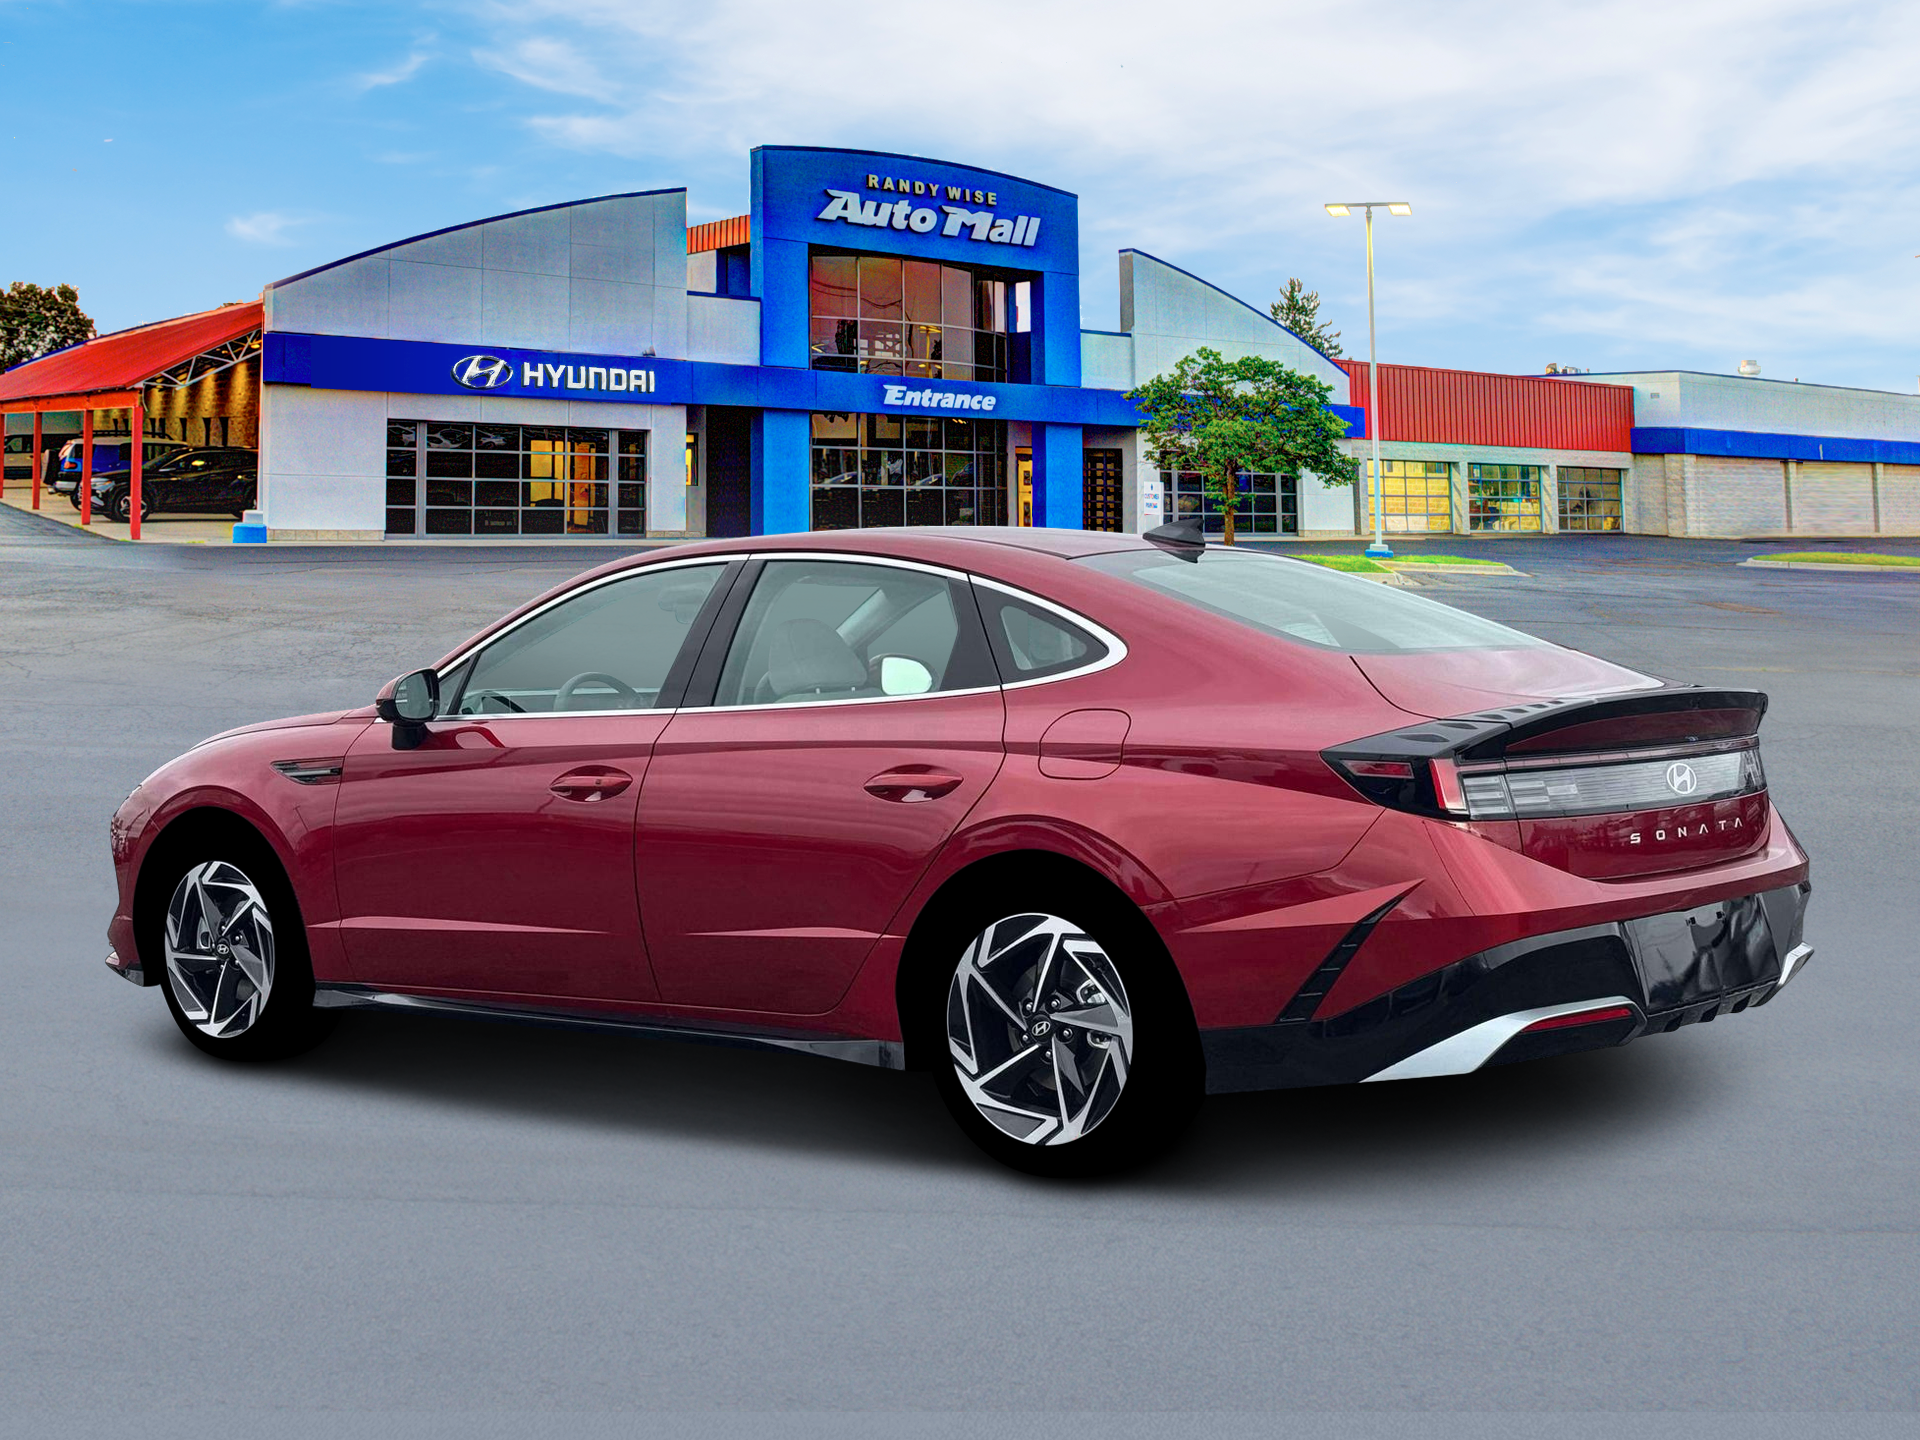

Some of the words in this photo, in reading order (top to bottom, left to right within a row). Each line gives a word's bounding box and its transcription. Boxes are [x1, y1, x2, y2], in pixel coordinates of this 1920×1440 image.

[867, 174, 939, 197] RANDY
[946, 186, 997, 206] WISE
[816, 189, 938, 233] Auto
[941, 205, 1041, 247] Mall
[522, 362, 656, 393] HYUNDAI
[882, 384, 997, 411] Entrance
[1630, 817, 1743, 844] SONATA
